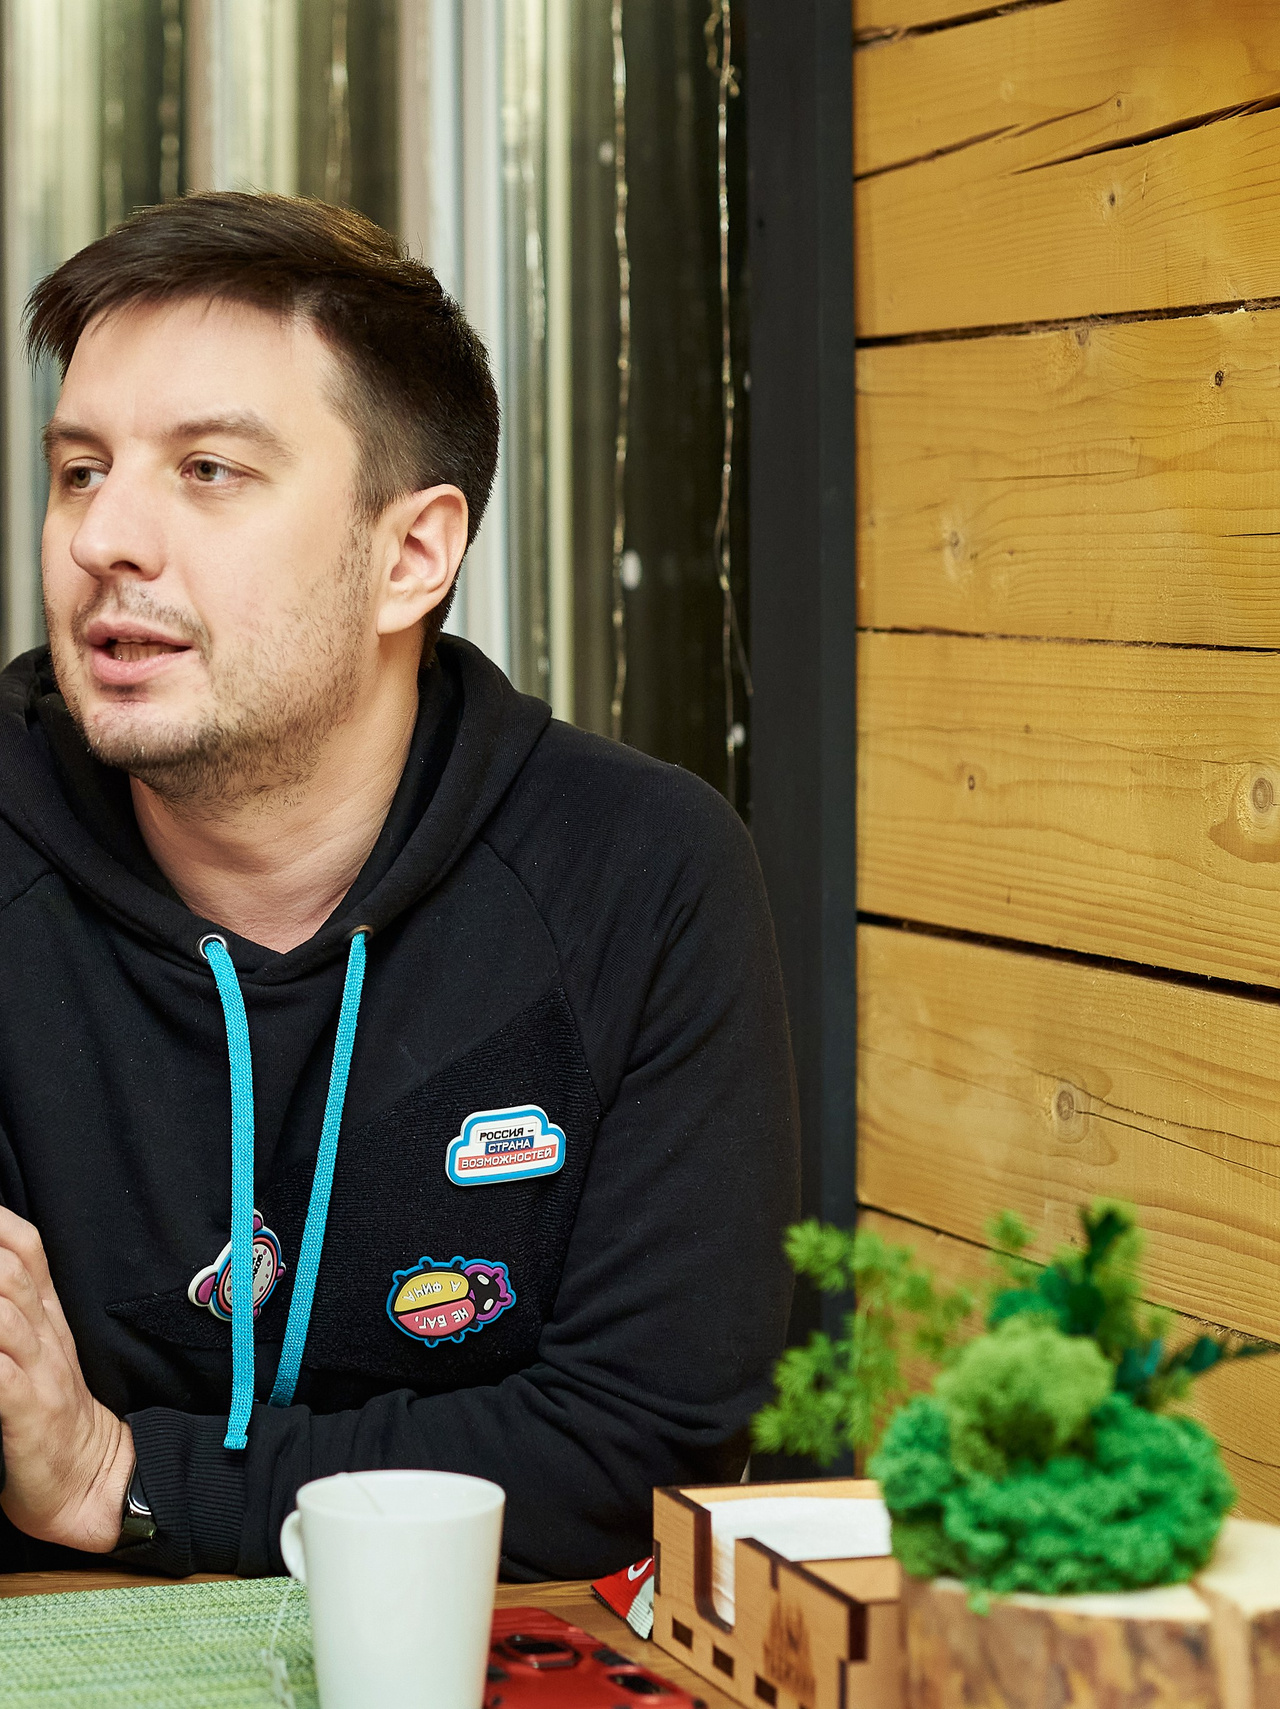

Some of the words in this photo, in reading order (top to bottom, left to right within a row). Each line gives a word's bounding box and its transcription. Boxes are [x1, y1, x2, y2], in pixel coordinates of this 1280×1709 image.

[480, 1127, 524, 1141] РОССИЯ
[488, 1139, 530, 1153] СТРАНА
[461, 1147, 552, 1168] ВОЗМОЖНОСТЕЙ
[402, 1281, 443, 1302] ФИЧА
[449, 1280, 461, 1293] А
[414, 1314, 448, 1330] БАГ,
[450, 1307, 470, 1323] НЕ
